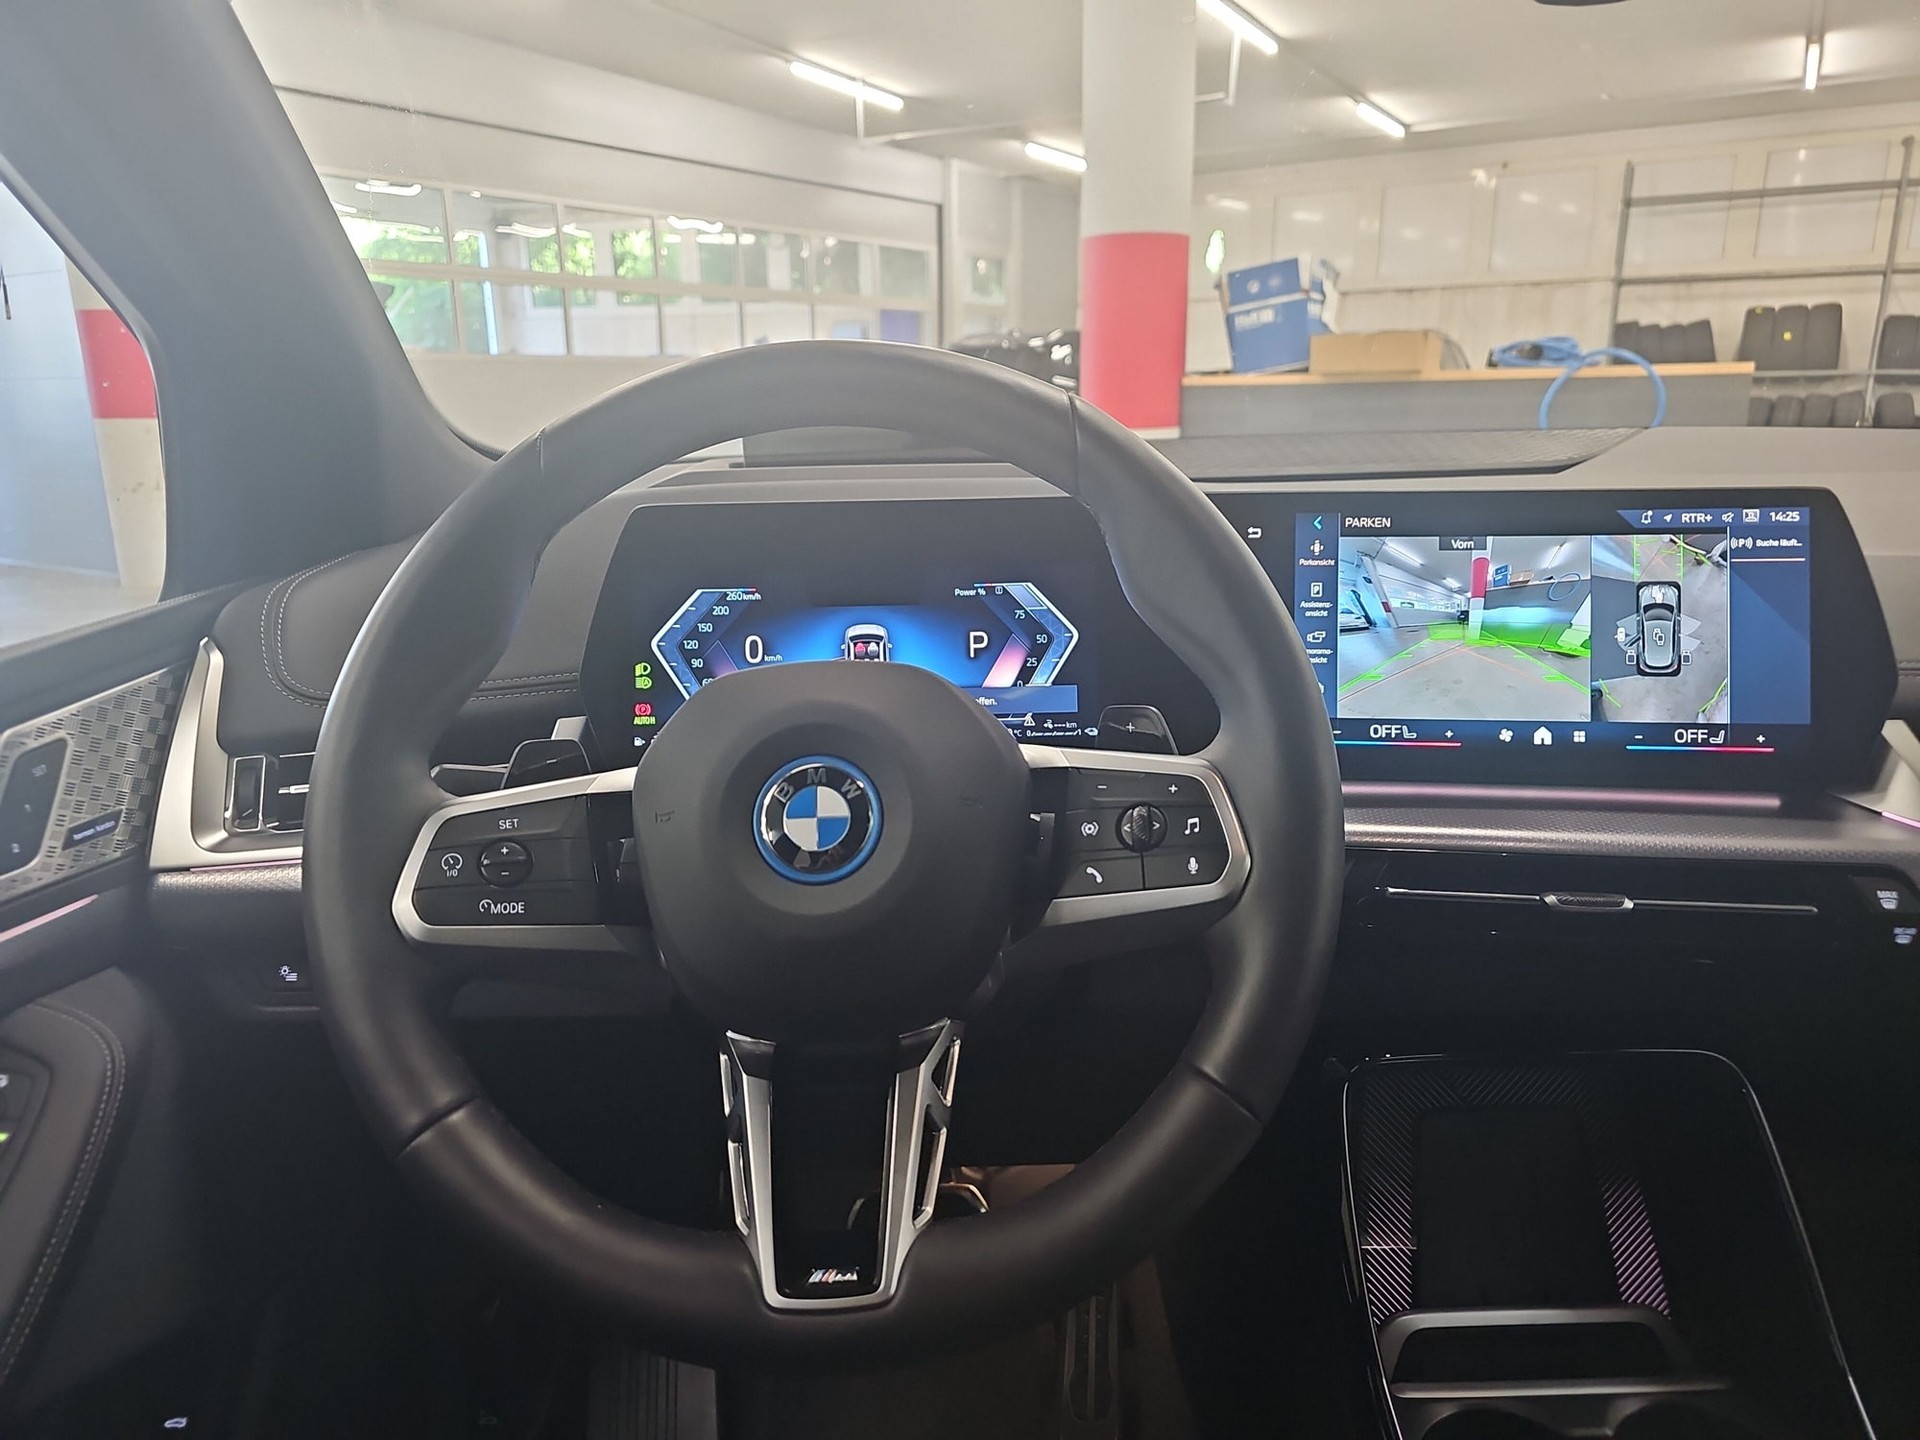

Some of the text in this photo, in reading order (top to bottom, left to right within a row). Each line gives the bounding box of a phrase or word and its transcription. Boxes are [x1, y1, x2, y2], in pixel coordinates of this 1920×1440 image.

[1681, 512, 1713, 523] RTR+
[1769, 511, 1800, 522] 14:25
[1345, 517, 1391, 528] PARKEN
[1451, 538, 1474, 549] Vorn
[1755, 539, 1778, 548] Suche
[1299, 558, 1335, 566] Parkansicht
[954, 587, 986, 597] Power %
[1300, 600, 1334, 608] Assistenz-
[712, 605, 730, 616] 200
[1014, 609, 1026, 620] 75
[1304, 609, 1329, 617] ansicht
[697, 622, 713, 633] 150
[682, 639, 699, 650] 120
[969, 631, 989, 658] P
[1036, 634, 1048, 644] 50
[744, 634, 783, 664] 0 km/h
[690, 658, 704, 669] 90
[1026, 657, 1038, 668] 25
[1310, 656, 1328, 664] nsicht
[633, 716, 650, 725] AUTO
[1369, 724, 1401, 739] OFF
[1674, 728, 1708, 744] OFF
[774, 767, 862, 804] BMW
[498, 818, 519, 830] SET
[490, 902, 525, 914] MODE
